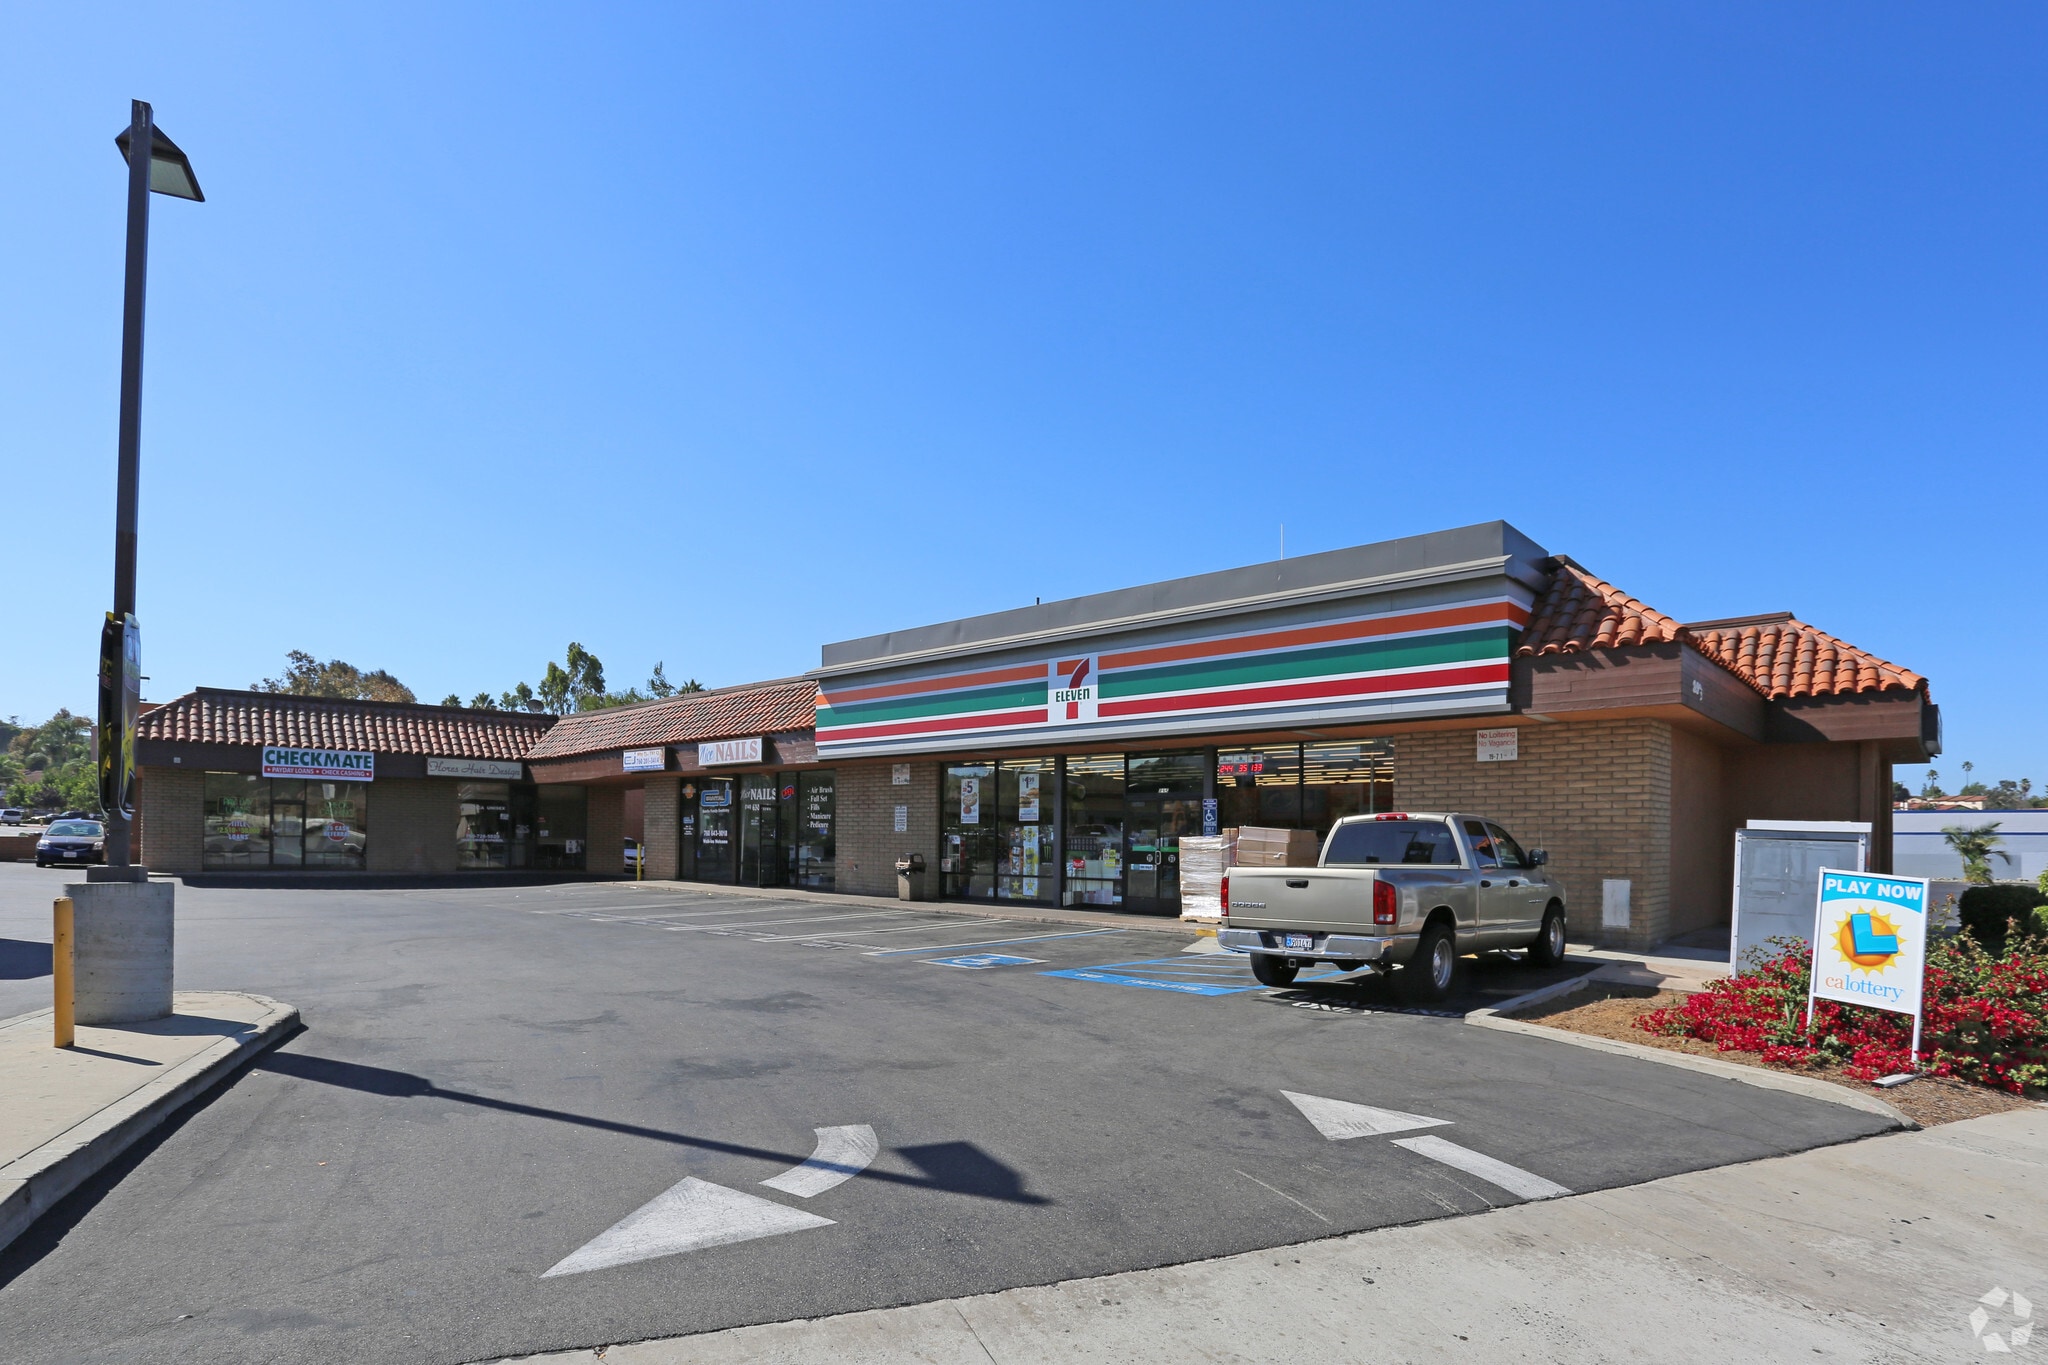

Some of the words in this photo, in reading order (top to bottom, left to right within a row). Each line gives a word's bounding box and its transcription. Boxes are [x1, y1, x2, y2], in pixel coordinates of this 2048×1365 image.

[1056, 657, 1090, 720] 7
[1489, 731, 1516, 739] Loitering
[715, 740, 758, 762] NAILS
[264, 749, 372, 768] CHECKMATE
[460, 763, 486, 774] Hair
[488, 764, 520, 777] Design
[1219, 765, 1234, 773] 244
[1238, 764, 1248, 772] 35
[1250, 763, 1263, 772] 133
[750, 788, 777, 800] NAILS
[810, 812, 831, 820] Manicure
[809, 820, 829, 828] Pedicure
[1826, 879, 1871, 894] PLAY
[1877, 884, 1921, 900] NOW
[1231, 901, 1266, 909] DODGE
